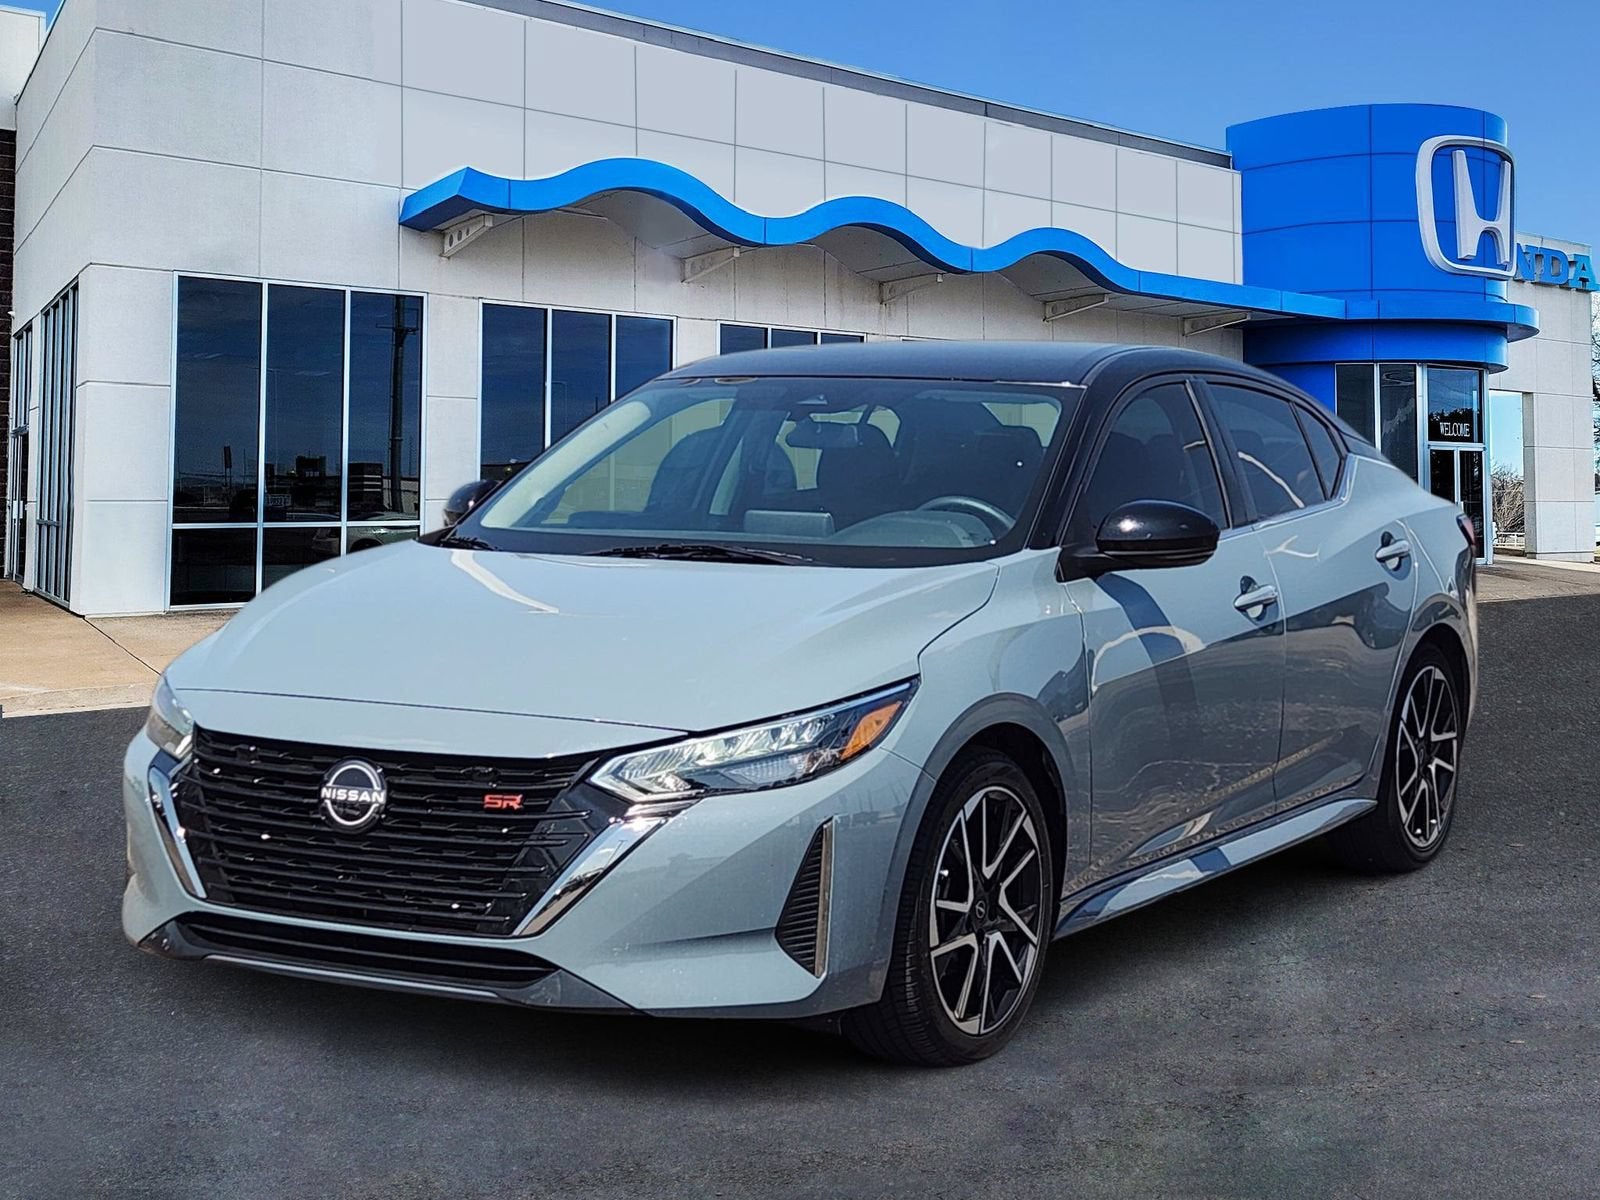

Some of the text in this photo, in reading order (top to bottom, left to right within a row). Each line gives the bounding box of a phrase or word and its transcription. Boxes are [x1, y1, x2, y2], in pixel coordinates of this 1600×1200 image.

[1515, 243, 1600, 291] NDA
[1439, 422, 1471, 437] WELCOME
[321, 787, 385, 804] NISSAN
[483, 794, 523, 810] SR
